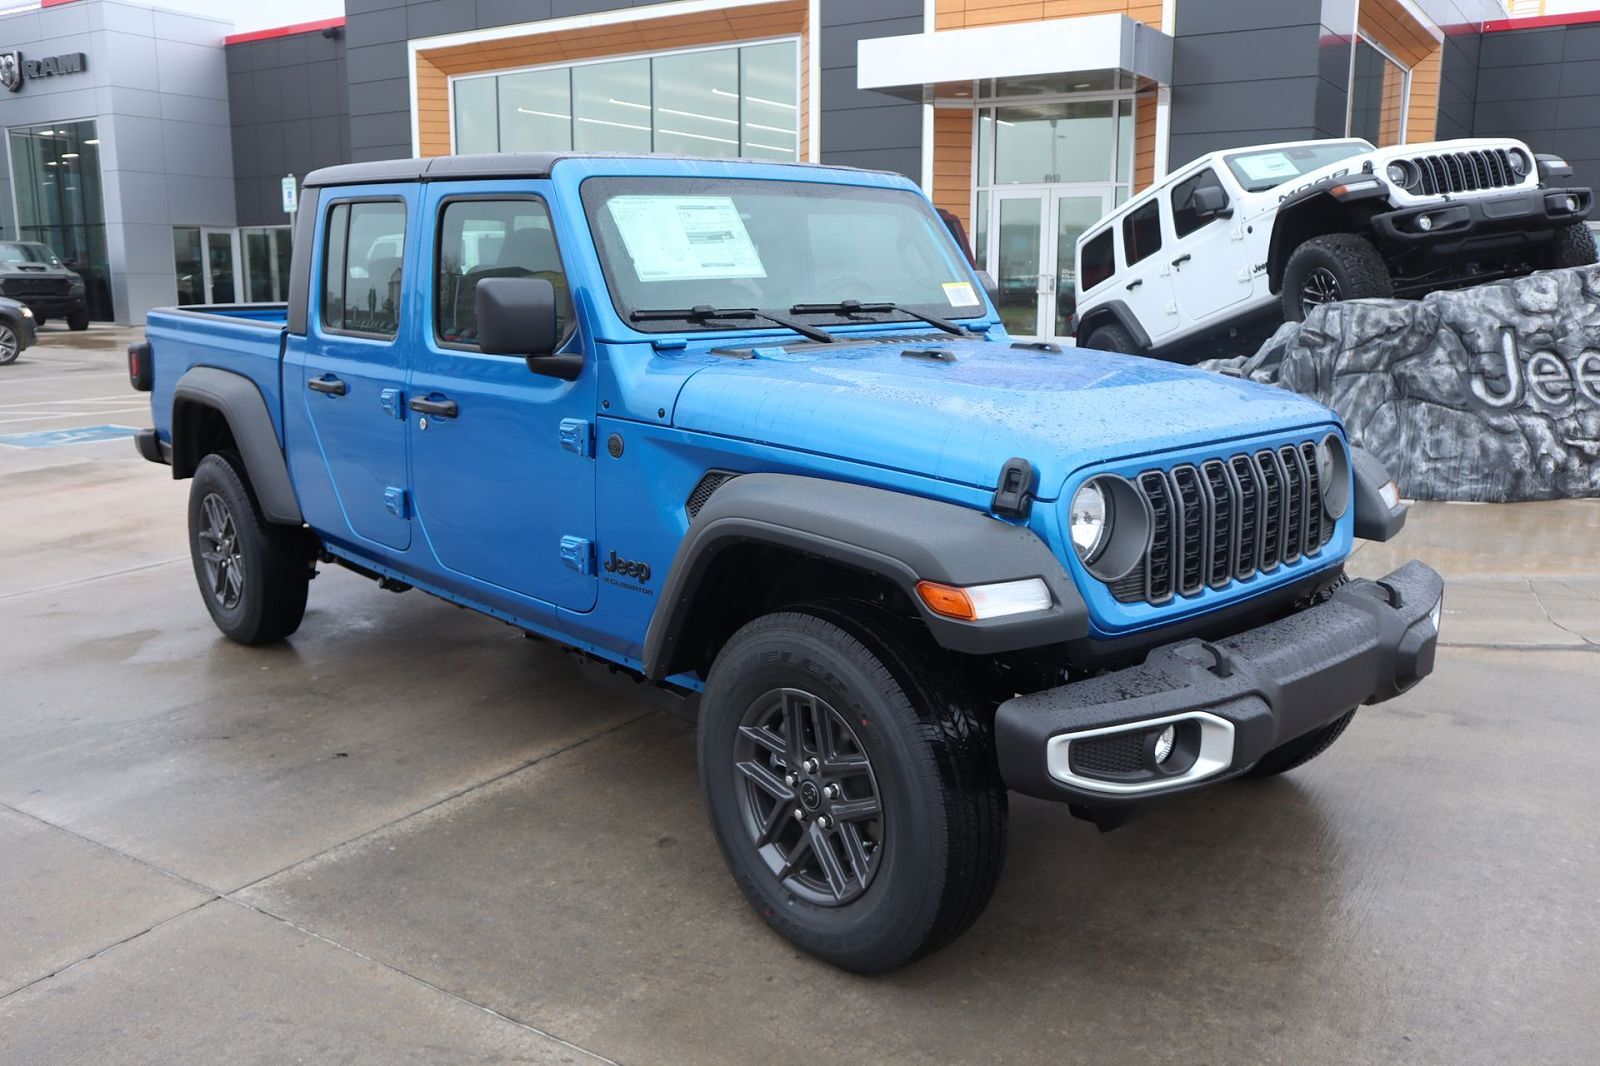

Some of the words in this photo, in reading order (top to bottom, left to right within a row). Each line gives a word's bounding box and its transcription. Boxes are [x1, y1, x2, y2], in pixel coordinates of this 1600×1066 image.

[23, 52, 86, 79] RAM
[604, 549, 651, 584] Jeep
[610, 579, 653, 596] GLADIATOR
